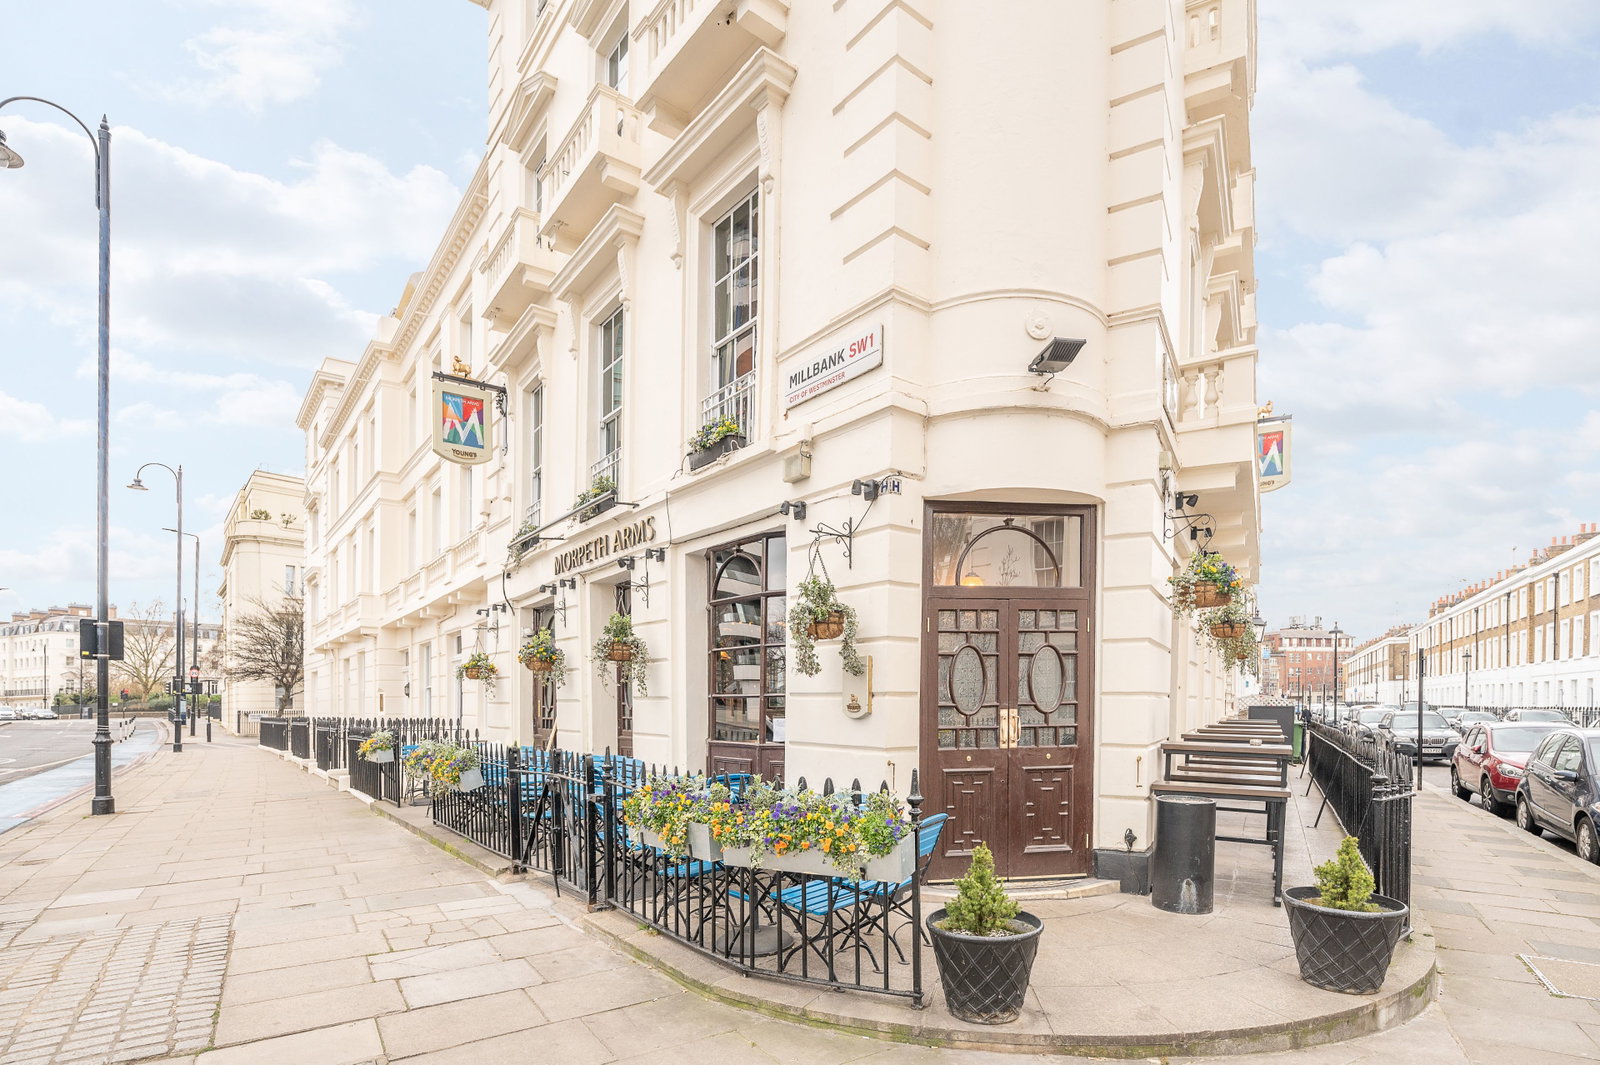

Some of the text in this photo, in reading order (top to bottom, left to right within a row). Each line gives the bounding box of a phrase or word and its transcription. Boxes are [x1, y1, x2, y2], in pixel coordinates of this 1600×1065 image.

[789, 333, 874, 389] MILLBANK SW1
[789, 371, 846, 403] CITY OF WESTMINSTER
[451, 448, 477, 458] YOUNG'S
[554, 515, 656, 576] MORPETH ARMS
